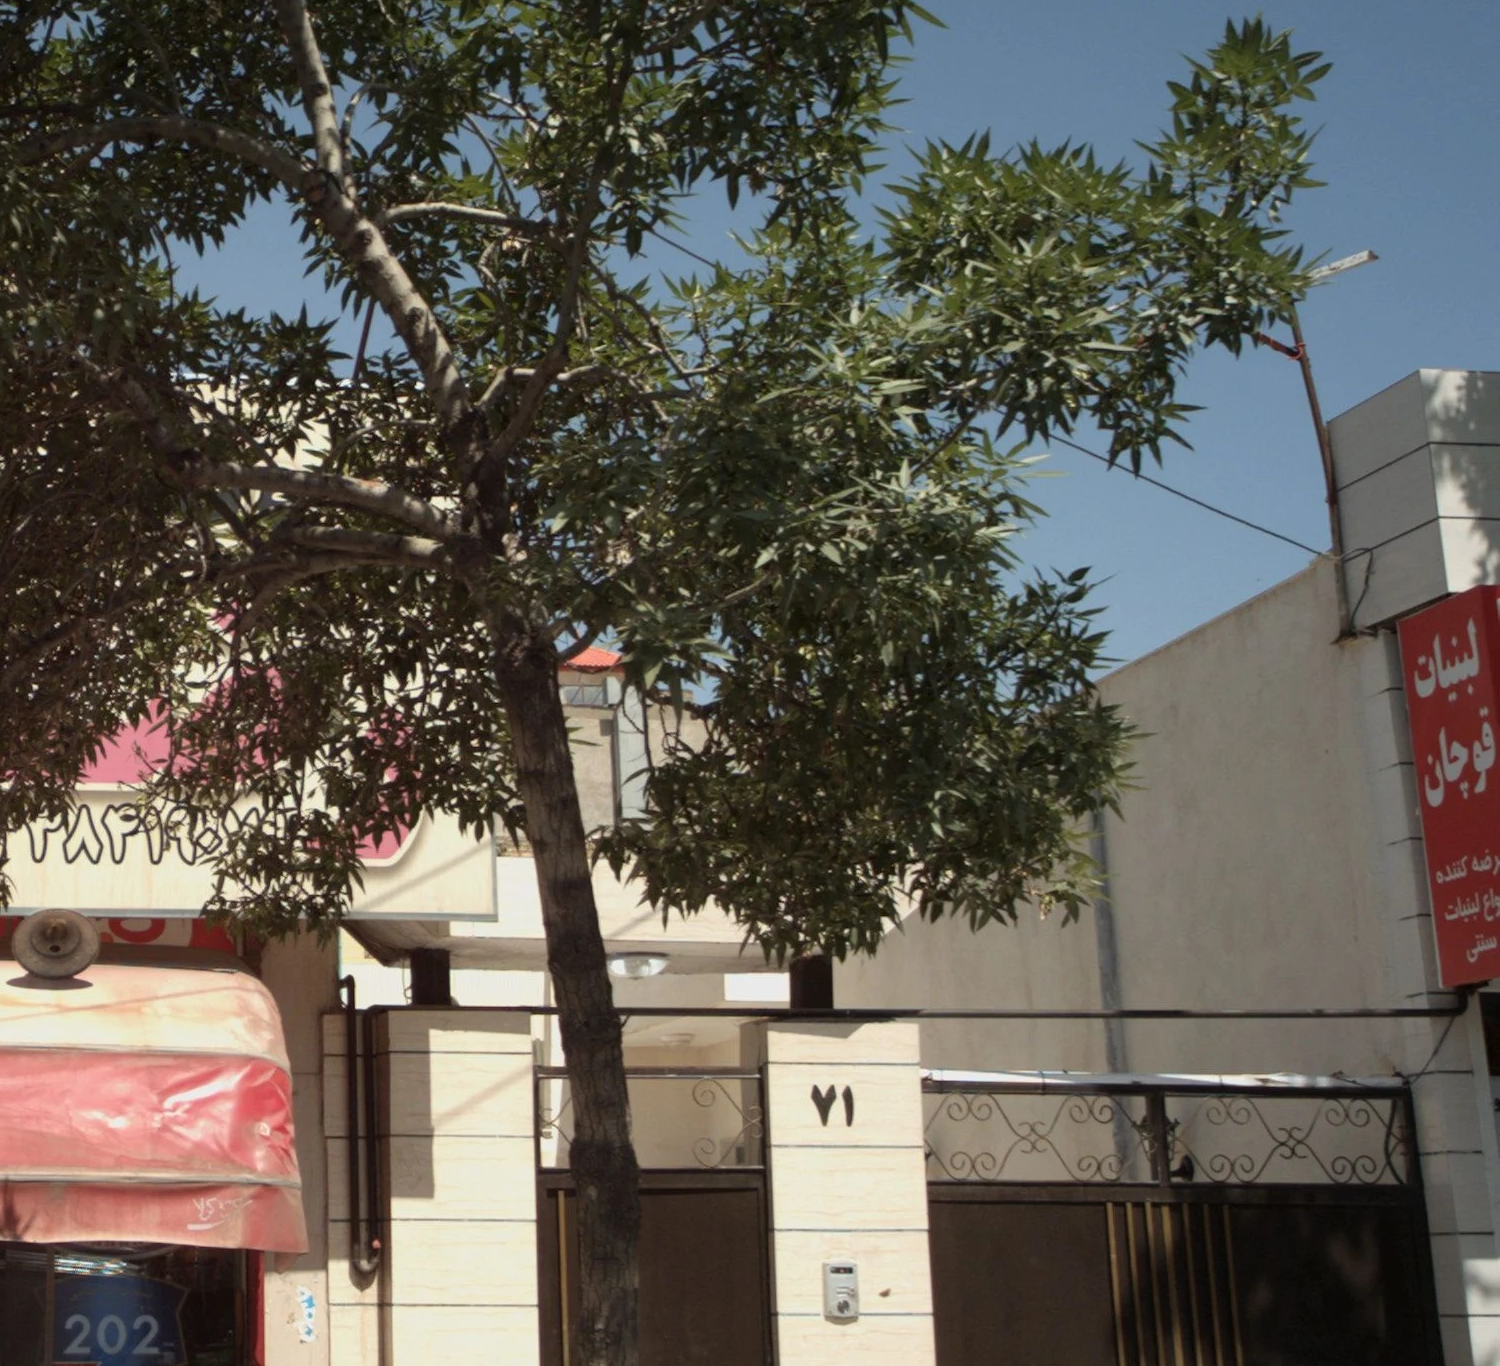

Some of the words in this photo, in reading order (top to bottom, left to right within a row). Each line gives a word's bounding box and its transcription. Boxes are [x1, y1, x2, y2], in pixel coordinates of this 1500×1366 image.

[1414, 617, 1480, 701] لبنیات
[1424, 706, 1496, 808] قوچان
[1435, 855, 1469, 884] کننده
[1471, 848, 1500, 876] رضه
[1444, 891, 1481, 923] لبنیات
[1466, 933, 1498, 963] سنتی
[810, 1083, 855, 1128] ۷۱
[63, 1314, 160, 1356] 202
